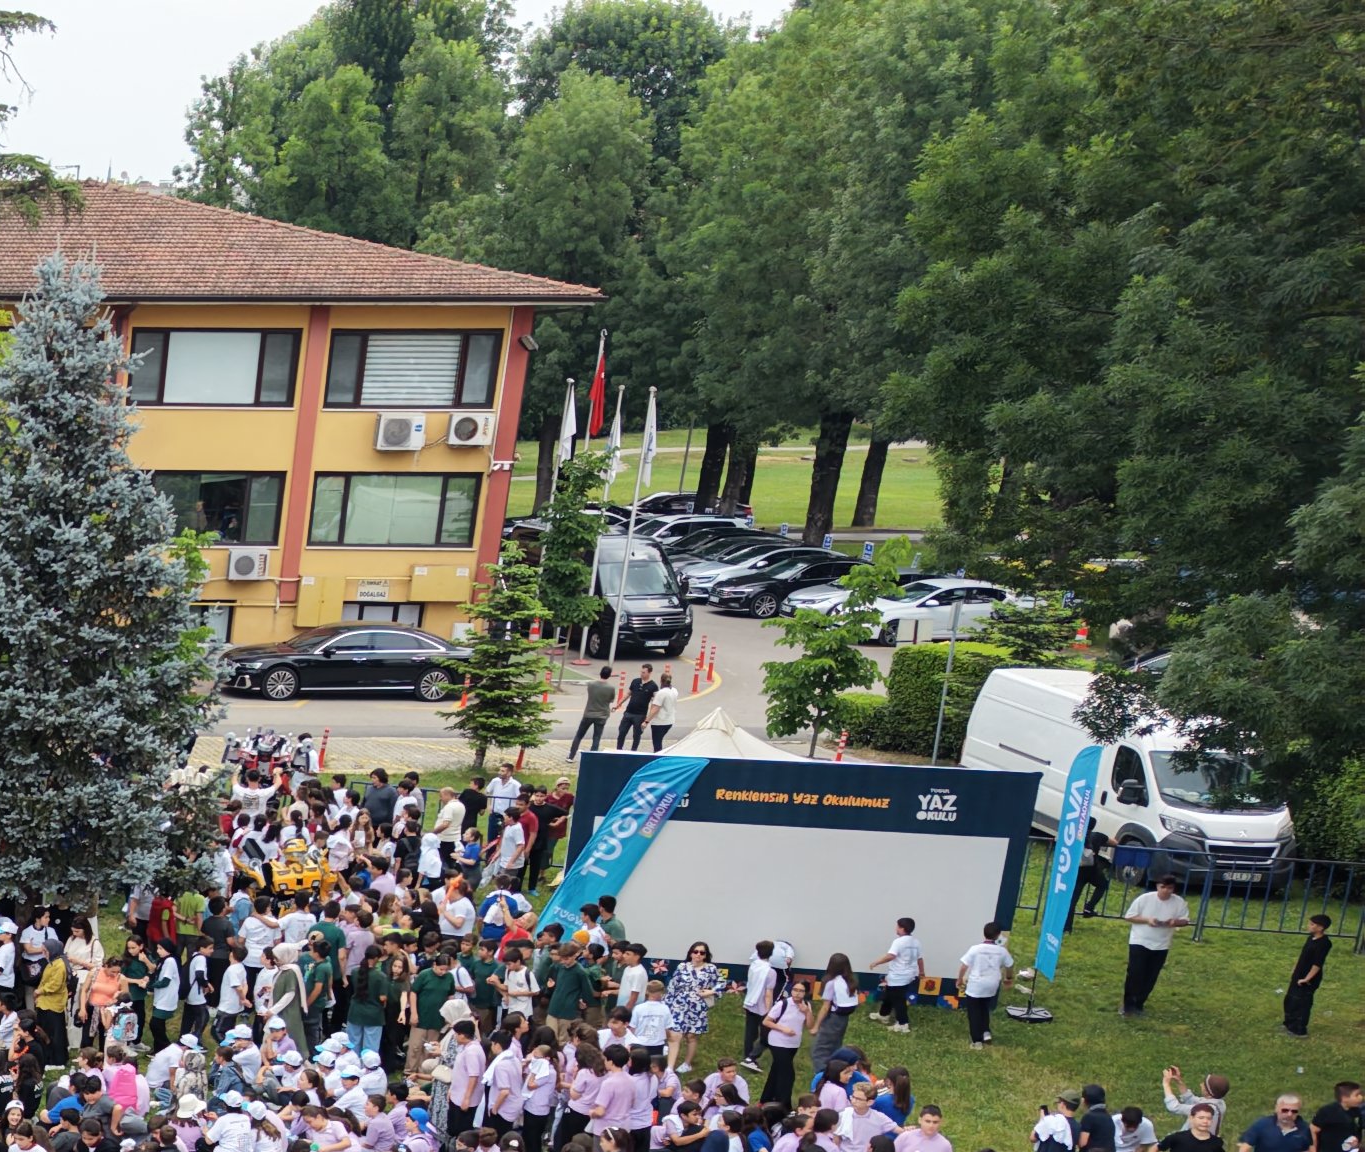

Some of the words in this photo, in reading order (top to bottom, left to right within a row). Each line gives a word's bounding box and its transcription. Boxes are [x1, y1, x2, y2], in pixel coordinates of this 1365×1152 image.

[642, 792, 677, 835] ORTAOKUL
[716, 788, 789, 804] Renklensin
[793, 792, 819, 805] Yaz
[822, 794, 890, 809] Okulumuz
[918, 794, 957, 812] YAZ
[580, 781, 668, 878] TÜGVA
[916, 810, 957, 822] OKULU
[1055, 778, 1087, 893] TÜGVA
